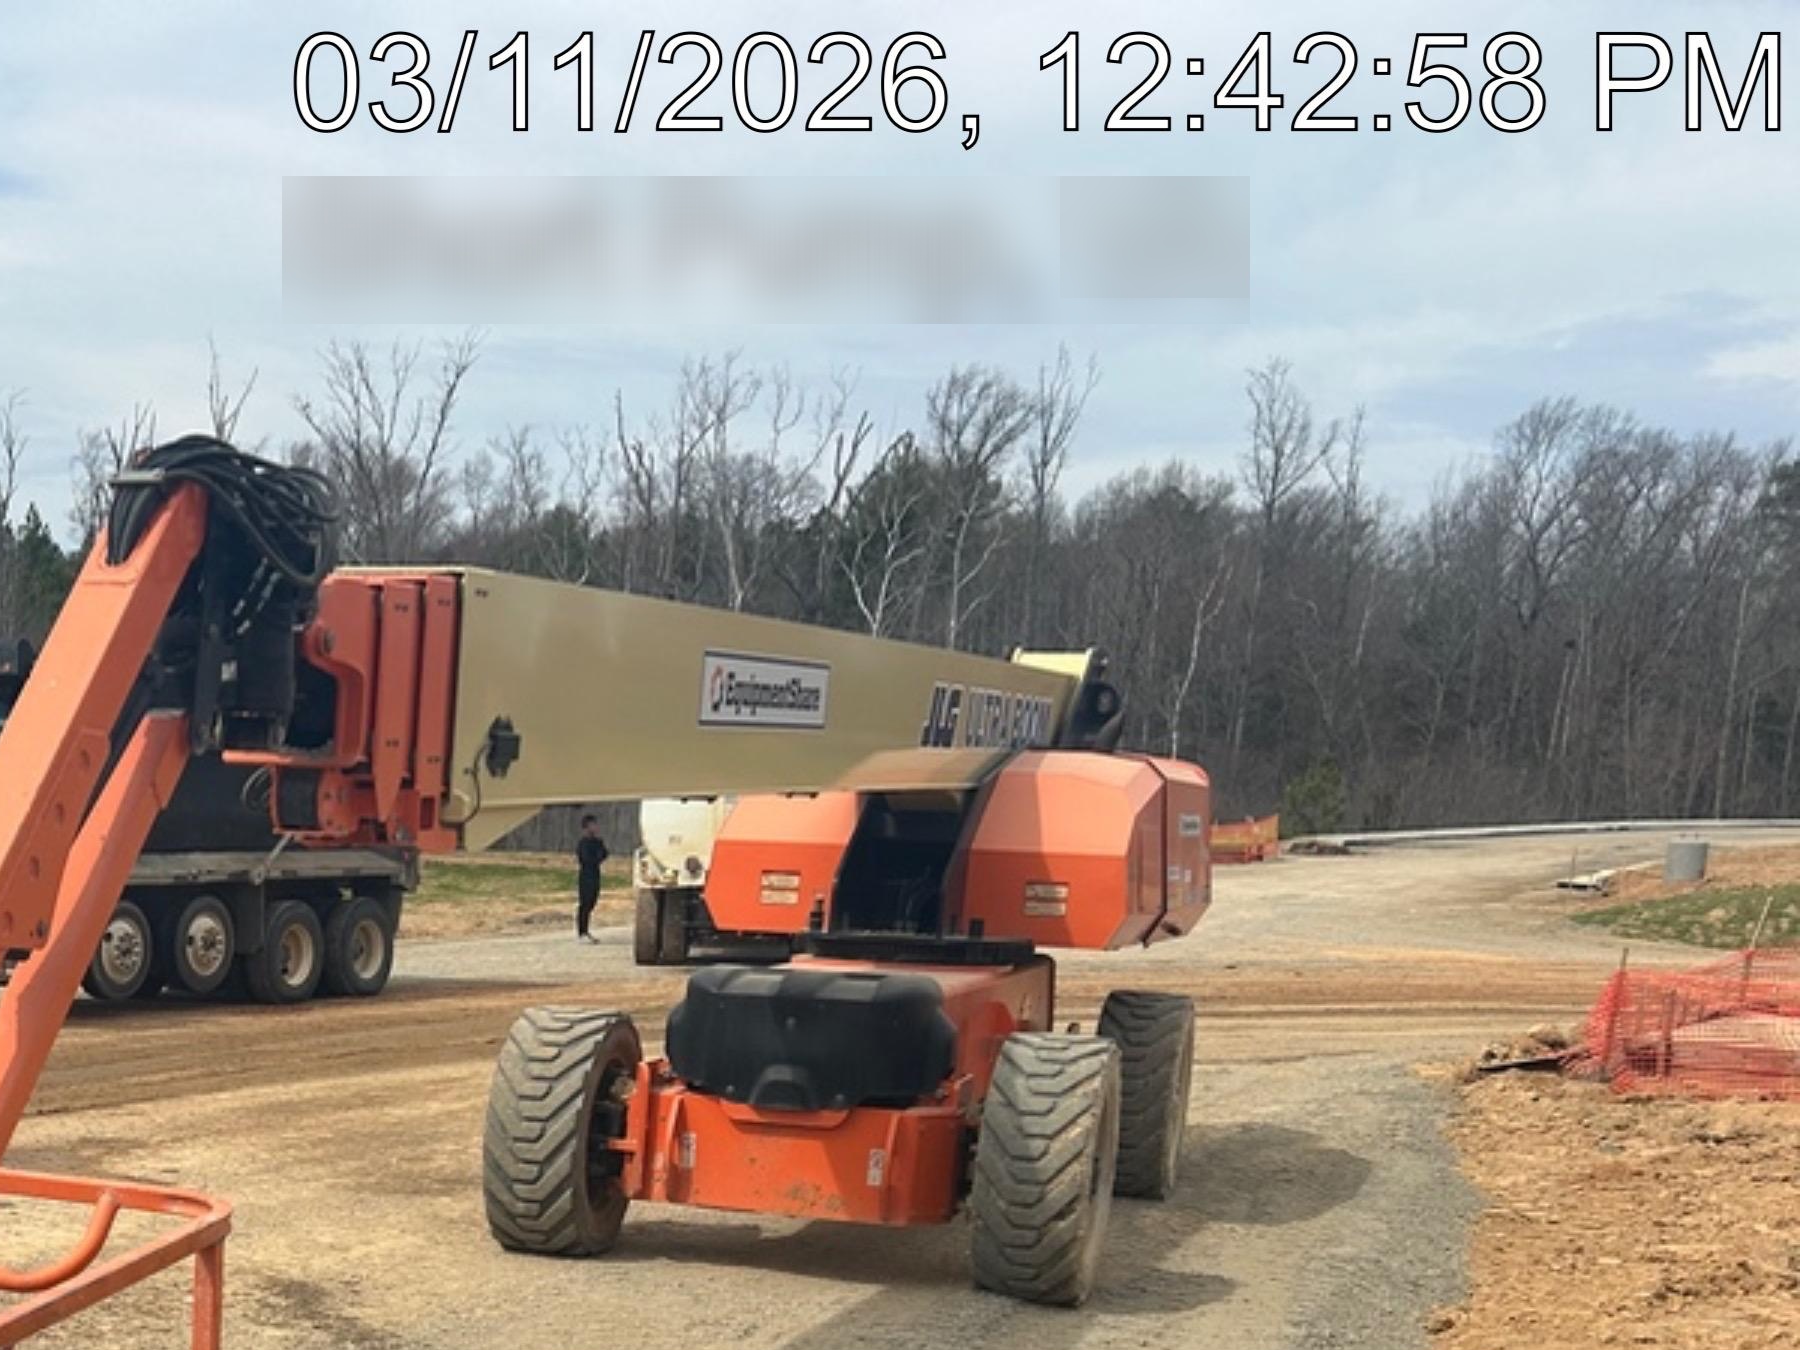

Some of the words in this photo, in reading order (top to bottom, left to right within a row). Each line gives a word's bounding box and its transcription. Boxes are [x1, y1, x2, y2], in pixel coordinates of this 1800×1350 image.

[726, 671, 820, 716] EquipmentShare
[919, 682, 965, 749] JLG
[965, 687, 1011, 748] ULTRA
